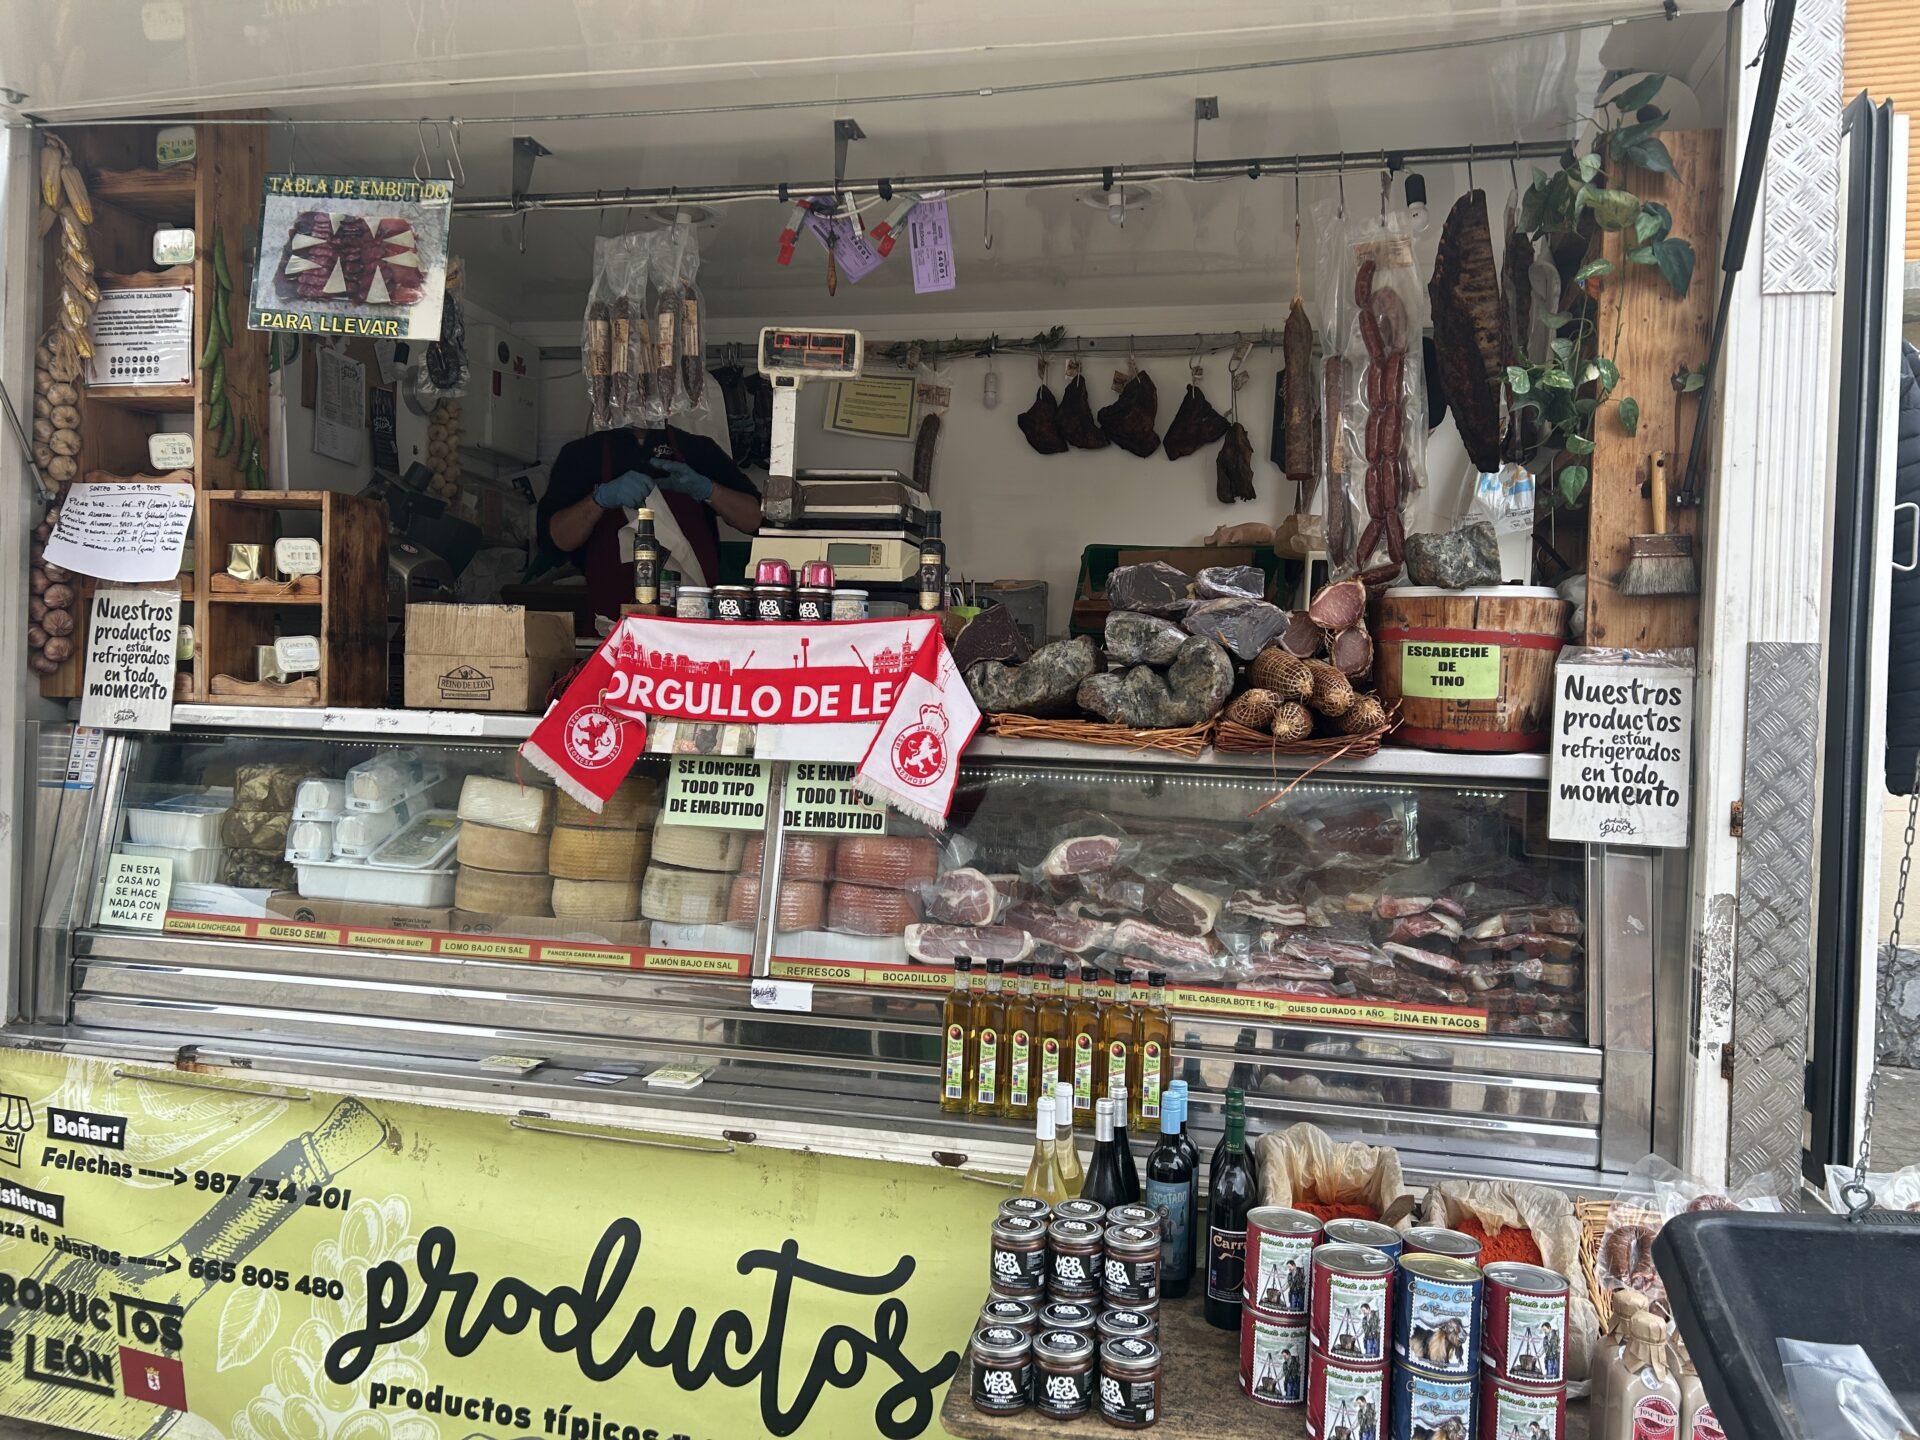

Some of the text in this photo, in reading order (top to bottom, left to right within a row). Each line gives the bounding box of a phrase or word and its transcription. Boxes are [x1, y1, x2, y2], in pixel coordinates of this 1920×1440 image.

[270, 177, 328, 193] TABLA
[333, 180, 354, 195] DE
[260, 313, 398, 336] PARA LLEVAR
[96, 597, 173, 621] Nuestros
[719, 599, 738, 609] MOR
[719, 604, 742, 616] VEGA
[759, 599, 778, 609] MOR
[759, 604, 782, 616] VEGA
[94, 622, 172, 645] productos
[126, 641, 152, 653] están
[1407, 646, 1489, 658] ESCABECHE
[92, 646, 170, 668] refrigerados
[104, 666, 155, 683] en todo
[1438, 662, 1457, 672] DE
[89, 679, 168, 700] momento
[441, 679, 462, 689] REINO
[463, 681, 472, 690] DE
[1430, 675, 1465, 687] TINO
[1564, 675, 1682, 706] Nuestros
[791, 684, 840, 718] DE
[850, 681, 901, 716] LE
[1563, 707, 1682, 734] productos
[1612, 731, 1652, 745] están
[1561, 736, 1681, 764] refrigerados
[678, 760, 761, 778] SE LONCHEA
[797, 764, 857, 782] SE ENVA
[1581, 762, 1658, 785] en todo
[681, 779, 755, 797] TODO TIPO
[796, 787, 835, 804] TODO
[1560, 779, 1680, 808] momento
[669, 799, 765, 817] DE EMBUTIDO
[783, 810, 883, 830] DE EMBUTIDO
[121, 863, 161, 875] EN ESTA
[117, 875, 161, 887] CASA NO
[115, 887, 158, 898] SE HACE
[109, 898, 161, 911] NADA CON
[111, 910, 153, 921] MALA FE
[169, 920, 242, 933] CECINA LONCHEADA
[270, 926, 327, 940] QUESO SEMI
[354, 935, 424, 947] SALCHICHÓN DE BUEY
[444, 942, 524, 954] LOMO BAJO EN SAL
[650, 956, 733, 970] JAMÓN BAJO EN SAL
[786, 966, 947, 984] REFRESCOS BOCADILLOS
[1178, 993, 1198, 1002] MIEL
[1199, 995, 1232, 1005] CASERA
[1233, 997, 1256, 1007] BOTE
[1287, 1005, 1318, 1015] QUESO
[1319, 1006, 1357, 1017] CURADO
[1365, 1008, 1385, 1019] AÑO
[1393, 1012, 1480, 1029] CINA EN TACOS
[53, 1113, 120, 1143] Boñar:
[40, 1146, 352, 1211] Felechas 987 734 201
[0, 1182, 57, 1219] stierna
[30, 1224, 49, 1246] de
[54, 1234, 121, 1267] abastos
[188, 1257, 237, 1284] 665
[241, 1265, 290, 1292] 805
[294, 1275, 344, 1301] 480
[994, 1249, 1016, 1262] MOR
[1055, 1254, 1080, 1267] MOR
[994, 1255, 1022, 1275] VEGA
[1055, 1262, 1086, 1279] VEGA
[324, 1217, 961, 1438] productos
[24, 1332, 116, 1398] LEÓN
[984, 1371, 1013, 1383] MOR
[1046, 1375, 1075, 1388] MOR
[984, 1378, 1018, 1394] VEGA
[1046, 1383, 1080, 1399] VEGA
[368, 1381, 660, 1440] productos típicos
